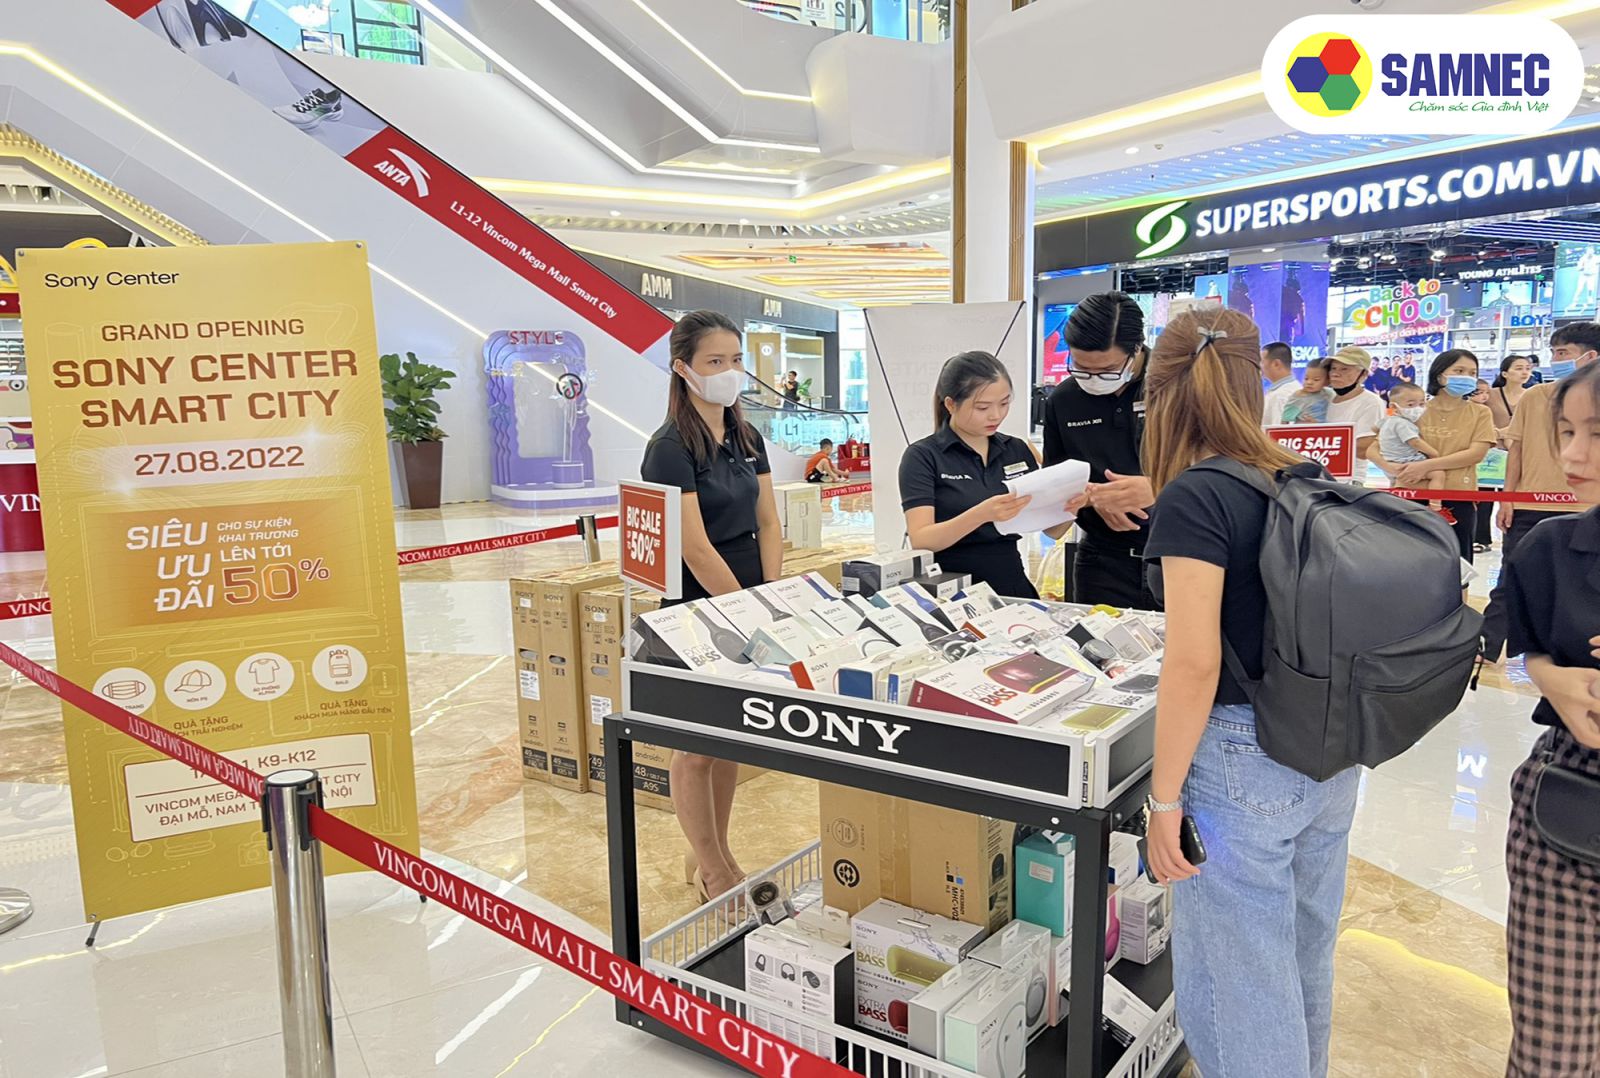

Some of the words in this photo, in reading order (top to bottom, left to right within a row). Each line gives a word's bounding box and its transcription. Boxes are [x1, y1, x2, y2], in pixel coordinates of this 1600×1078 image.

[373, 160, 411, 187] ANTA
[450, 200, 482, 227] L1-12
[482, 220, 518, 252] Vincom
[519, 247, 547, 274] Mega
[547, 265, 570, 286] Mall
[569, 281, 599, 306] Smart
[598, 301, 618, 320] City
[44, 272, 99, 291] Sony
[106, 270, 180, 287] Center
[1458, 269, 1494, 280] YOUNG
[1369, 281, 1416, 303] Back
[1418, 278, 1441, 296] to
[1352, 293, 1455, 330] SCHOOL
[101, 322, 189, 342] GRAND
[197, 318, 305, 338] OPENING
[53, 356, 175, 389] SONY
[191, 349, 358, 383] CENTER
[81, 393, 233, 428] SMART
[248, 389, 340, 420] CITY
[785, 422, 799, 436] L1
[1304, 436, 1342, 450] SALE
[134, 445, 305, 476] 27.08.2022
[1390, 490, 1417, 498] CITY
[216, 521, 243, 532] CHO
[245, 520, 263, 534] SỰ
[264, 517, 292, 531] KIỆN
[626, 505, 640, 529] BIG
[640, 508, 661, 535] SALE
[126, 518, 208, 551] SIÊU
[217, 532, 247, 544] KHAI
[249, 528, 300, 542] TRƯƠNG
[220, 545, 256, 564] LÊN
[259, 542, 292, 562] TỚI
[399, 552, 431, 564] NCOM
[432, 547, 462, 559] MEGA
[463, 542, 490, 554] MALL
[491, 536, 525, 548] SMART
[525, 531, 548, 543] CITY
[631, 530, 655, 566] 50%
[157, 552, 212, 580] ƯU
[222, 557, 330, 606] 50%
[154, 580, 214, 612] ĐÃI
[515, 591, 534, 599] SONY
[543, 593, 564, 601] SONY
[9, 600, 51, 616] VINC
[584, 605, 611, 614] SONY
[653, 614, 677, 624] SONY
[691, 650, 722, 667] BASS
[811, 662, 829, 673] SONY
[319, 700, 341, 711] QUÀ
[979, 687, 1018, 707] BASS
[173, 718, 197, 730] QUÀ
[200, 715, 229, 728] TẶNG
[742, 697, 911, 755] SONY
[258, 749, 317, 768] K9-K12
[591, 757, 603, 767] 49
[333, 773, 361, 785] CITY
[635, 766, 646, 777] 48
[145, 797, 201, 814] VINCOM
[204, 790, 243, 807] MEGA
[330, 787, 353, 800] NỘI
[159, 814, 184, 827] ĐẠI
[215, 802, 247, 817] NAM
[856, 924, 878, 936] SONY
[373, 841, 457, 905] VINCOM
[462, 886, 526, 941] MEGA
[532, 921, 604, 981] MALL
[609, 961, 711, 1036] SMART
[718, 1016, 801, 1078] CITY
[856, 943, 886, 958] EXTRA
[856, 951, 886, 969] BASS
[857, 979, 880, 990] SONY
[857, 995, 887, 1012] EXTRA
[858, 1004, 888, 1023] BASS
